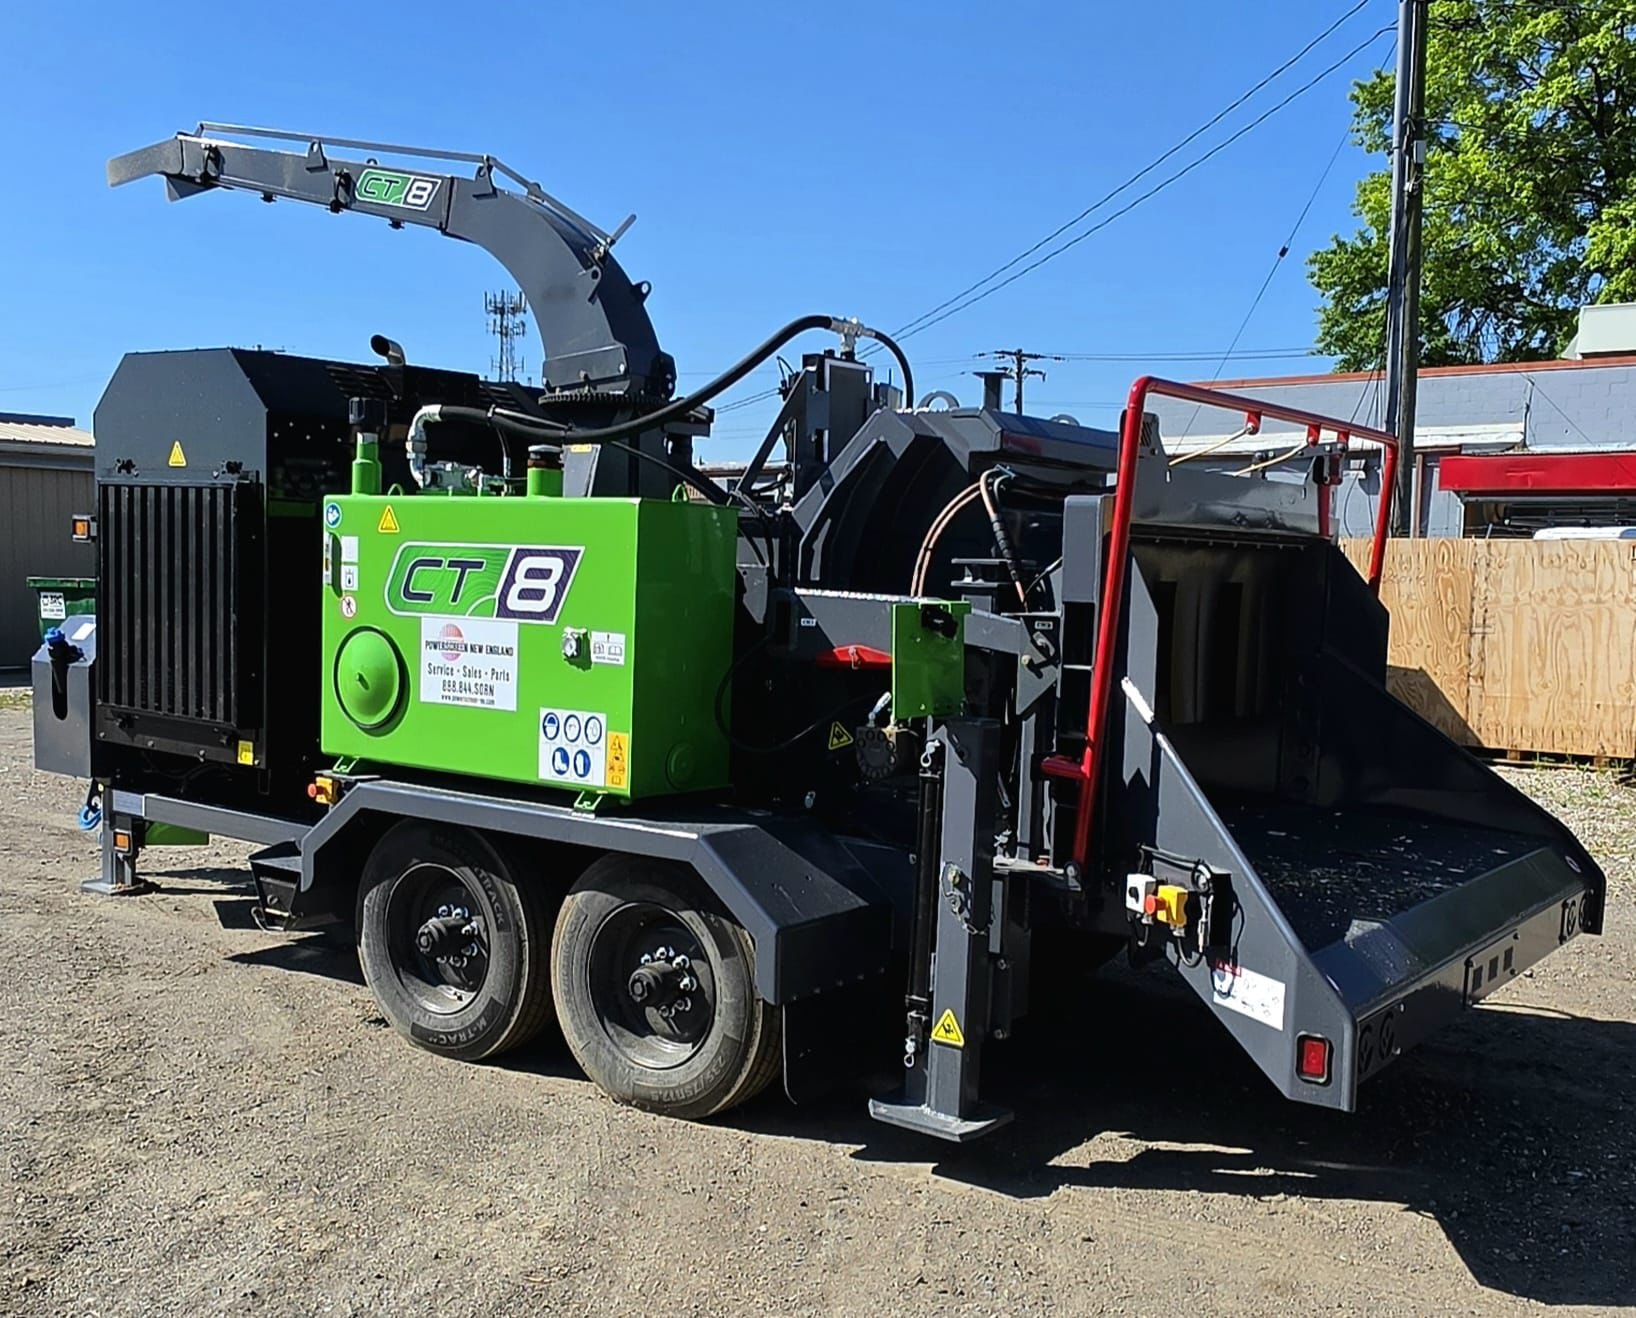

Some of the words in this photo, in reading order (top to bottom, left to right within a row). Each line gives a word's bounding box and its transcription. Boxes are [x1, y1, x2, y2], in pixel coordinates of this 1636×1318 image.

[362, 175, 401, 199] CT
[406, 181, 433, 205] 8
[401, 556, 486, 605] CT
[506, 556, 564, 613] 8
[425, 640, 468, 653] POWERSCREEN
[469, 643, 484, 654] NEW
[485, 645, 514, 657] ENGLAND
[427, 662, 454, 677] Service
[462, 665, 482, 679] Sales
[490, 667, 510, 682] Parts
